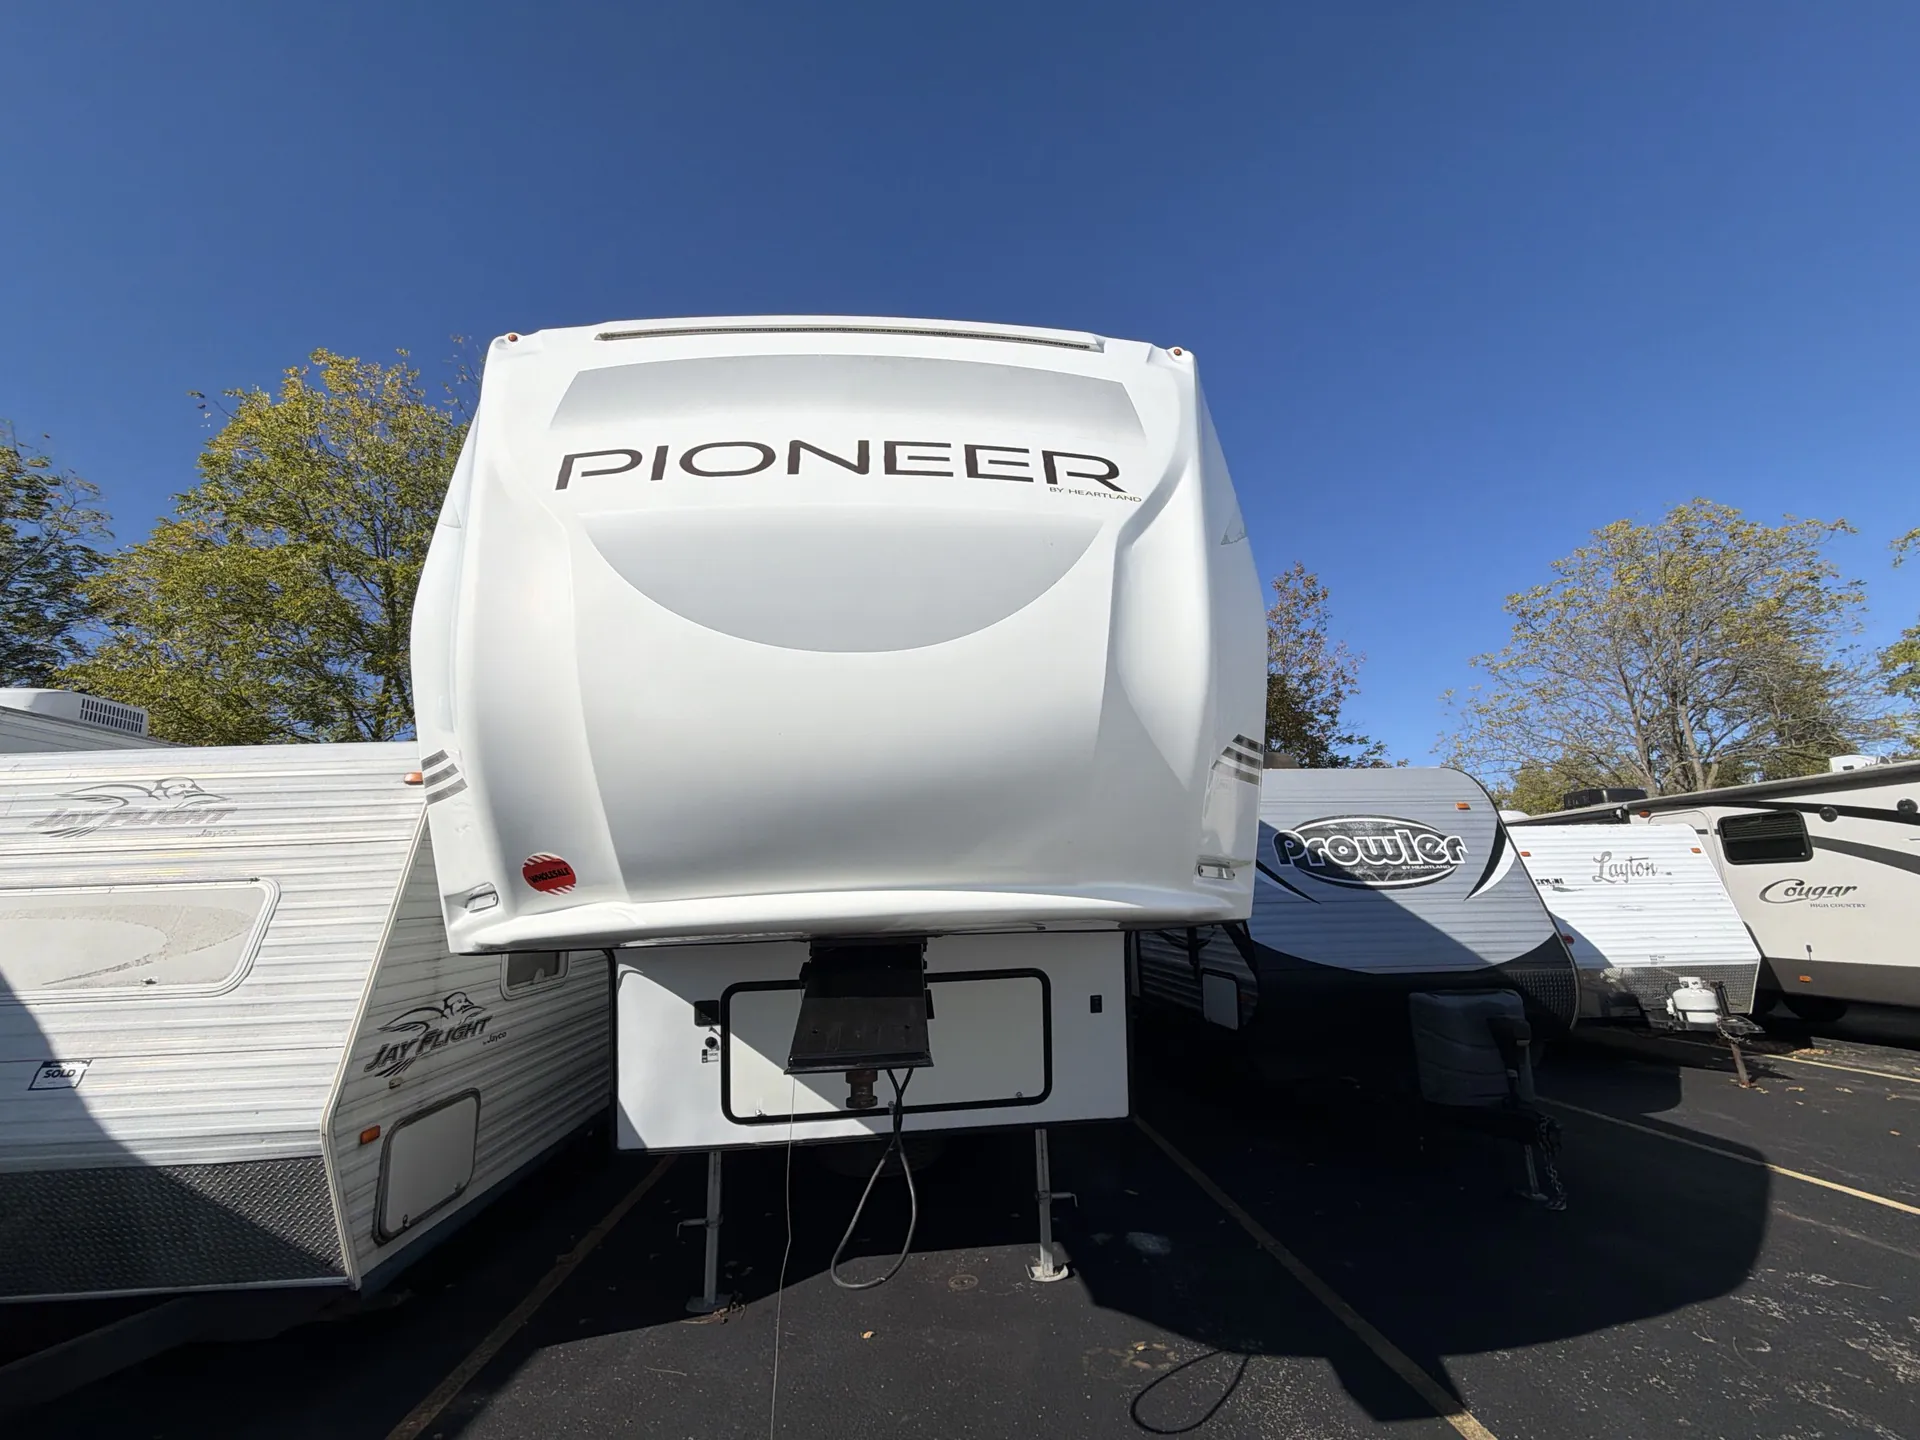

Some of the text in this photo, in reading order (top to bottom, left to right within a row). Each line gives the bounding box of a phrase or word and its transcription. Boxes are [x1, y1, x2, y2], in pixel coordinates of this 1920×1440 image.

[555, 439, 1126, 492] PIONEER
[1068, 488, 1142, 503] HEARTLAND
[99, 807, 237, 828] FLIGHT
[1272, 829, 1468, 866] Prowler
[1592, 851, 1658, 884] Layton
[1759, 878, 1858, 904] Cougar
[363, 1015, 493, 1073] JAY FLIGHT
[43, 1069, 77, 1079] SOLD
